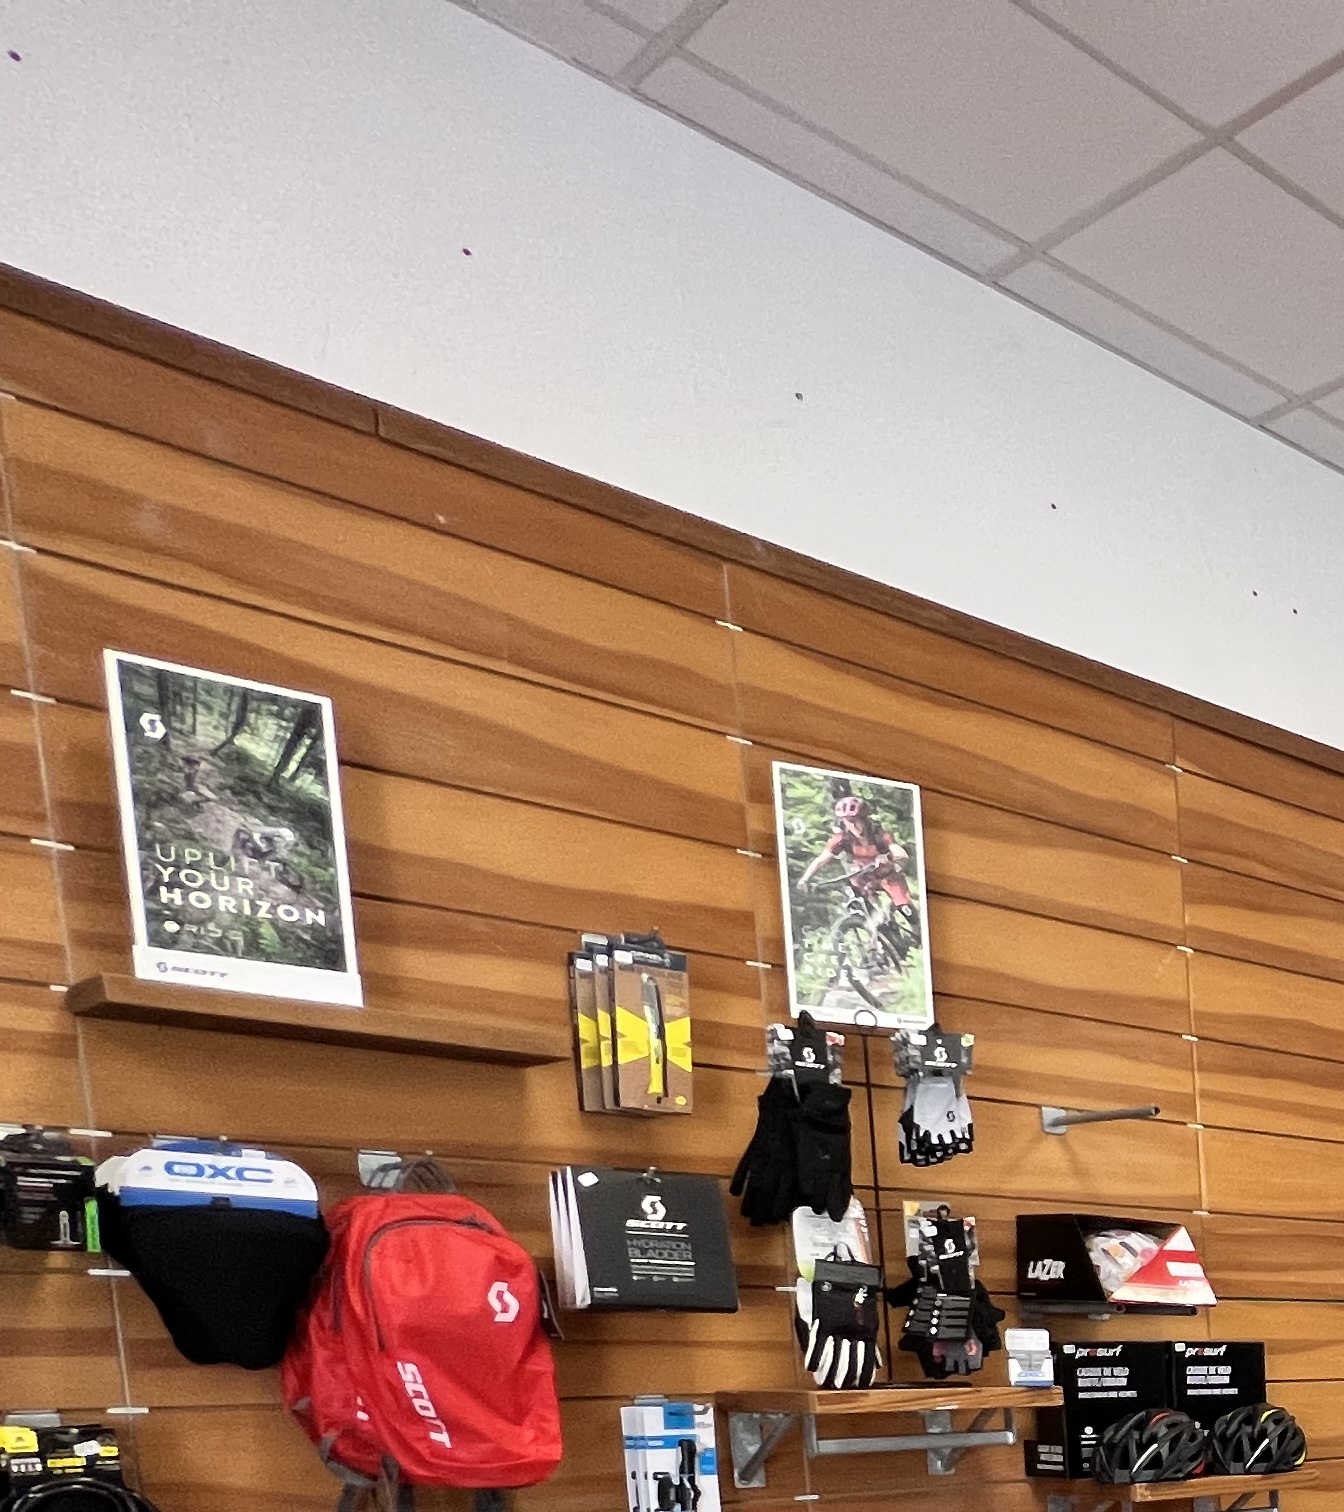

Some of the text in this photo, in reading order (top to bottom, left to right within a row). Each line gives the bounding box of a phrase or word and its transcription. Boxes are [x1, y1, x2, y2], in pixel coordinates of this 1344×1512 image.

[155, 843, 281, 879] UPLIFT
[155, 863, 254, 895] YOUR
[159, 886, 326, 927] HORIZON
[163, 1161, 274, 1184] OXC
[624, 1218, 688, 1231] SCOTT
[626, 1239, 692, 1251] HYDRATION
[628, 1250, 693, 1261] BLADDER
